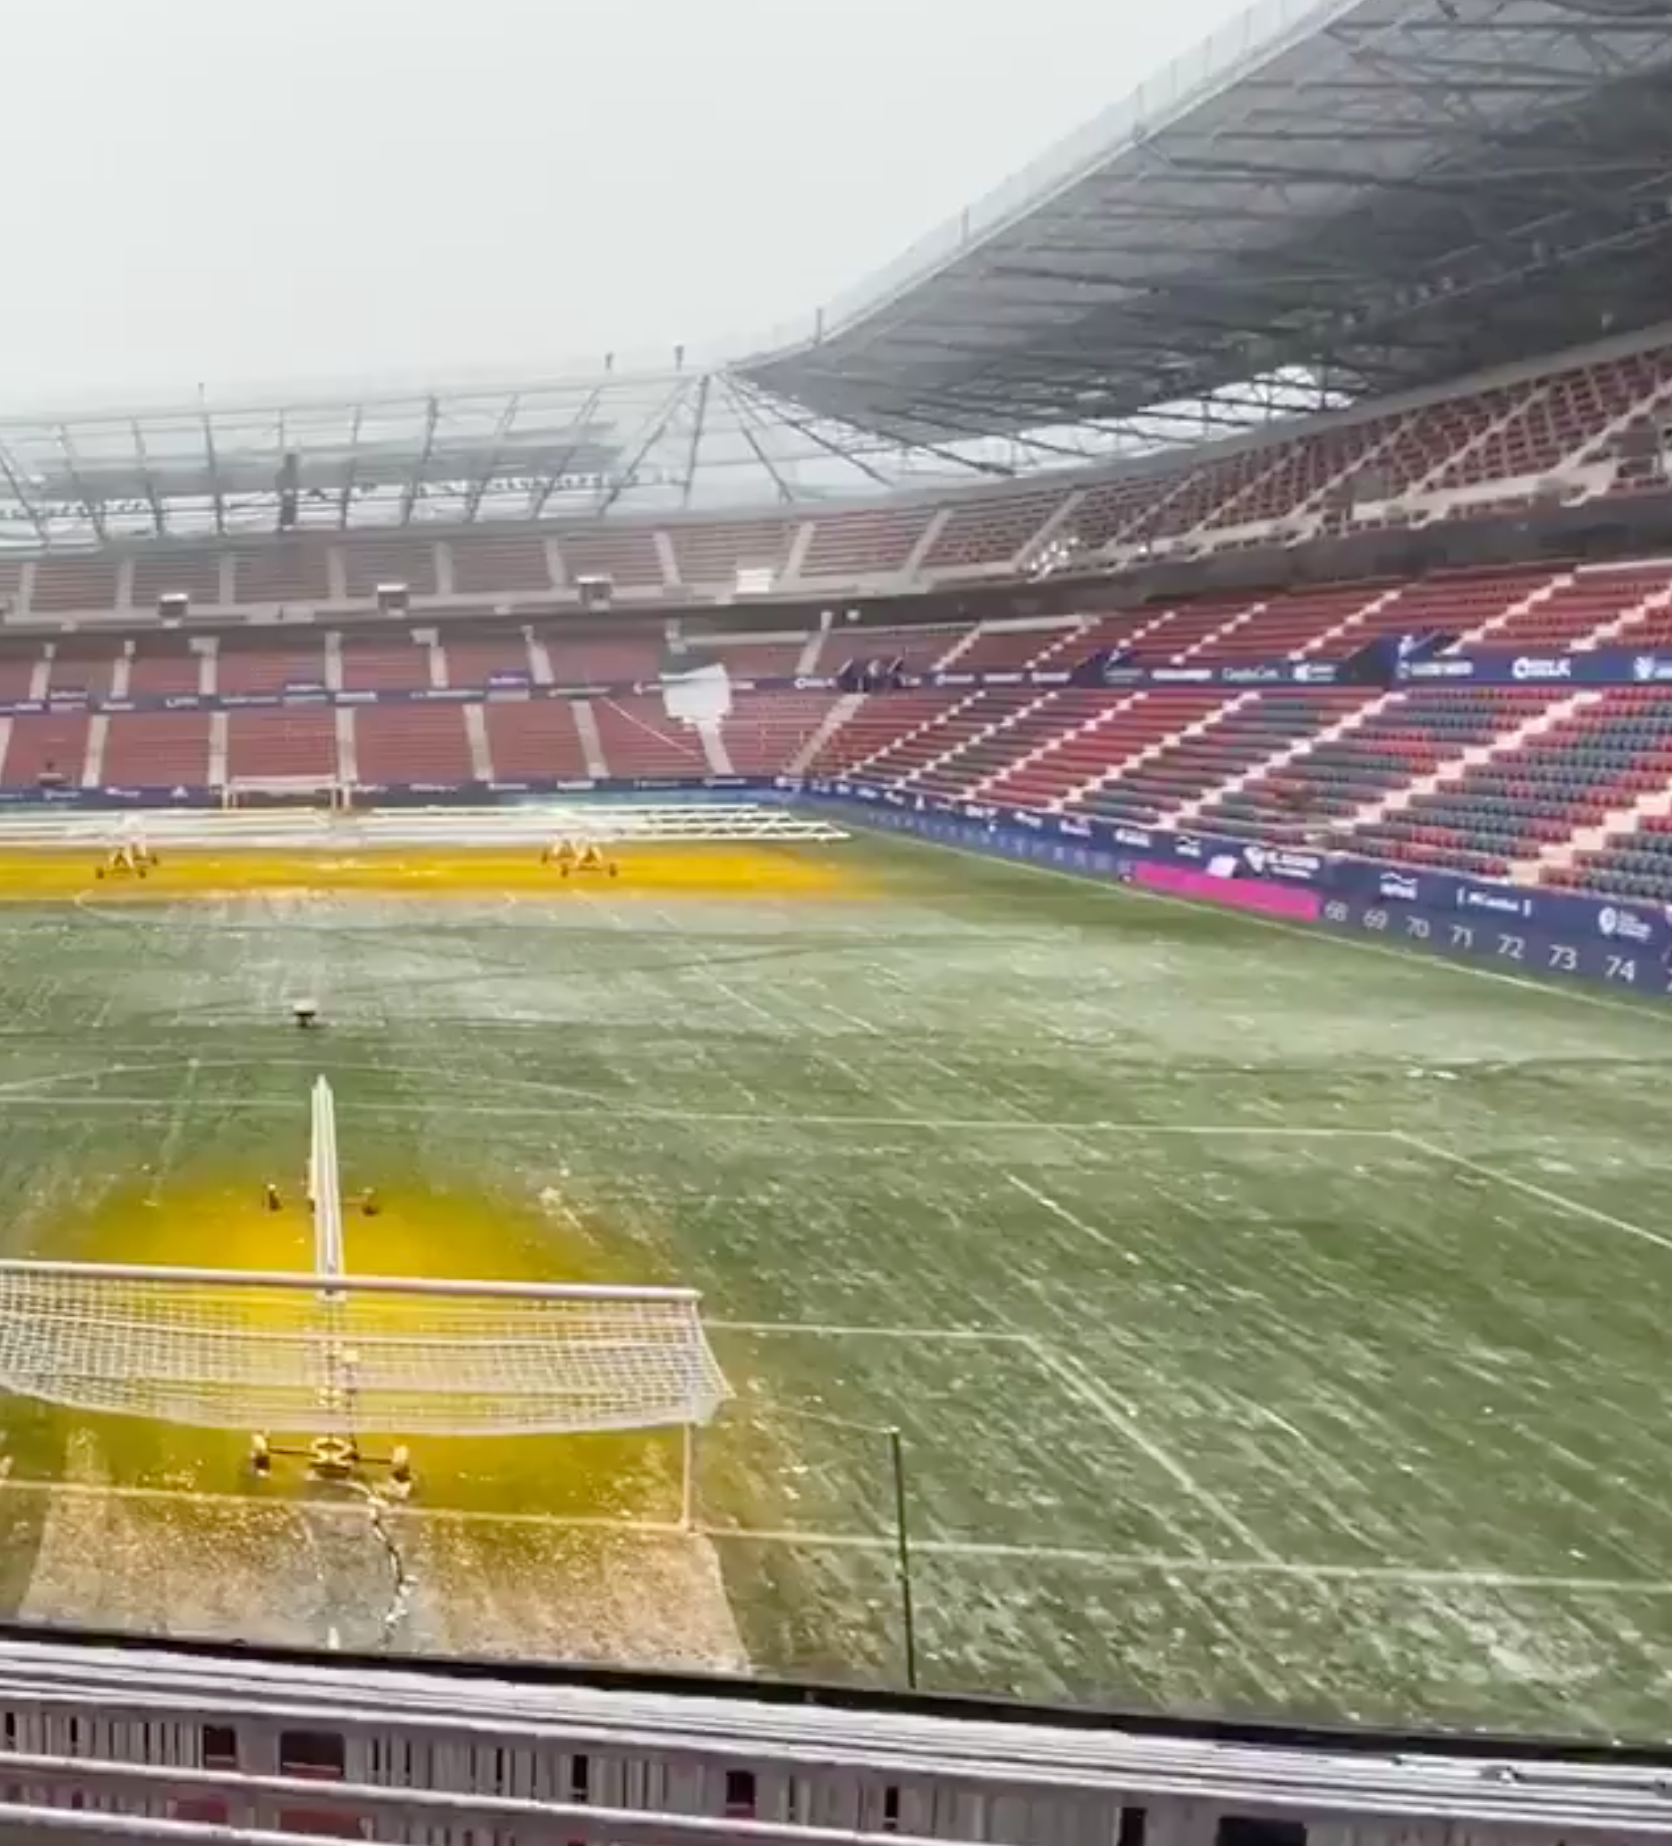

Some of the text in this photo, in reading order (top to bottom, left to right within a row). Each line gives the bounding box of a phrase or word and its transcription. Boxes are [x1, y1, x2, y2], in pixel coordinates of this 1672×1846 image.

[1325, 900, 1635, 981] 68 69 70 71 72 73 74
